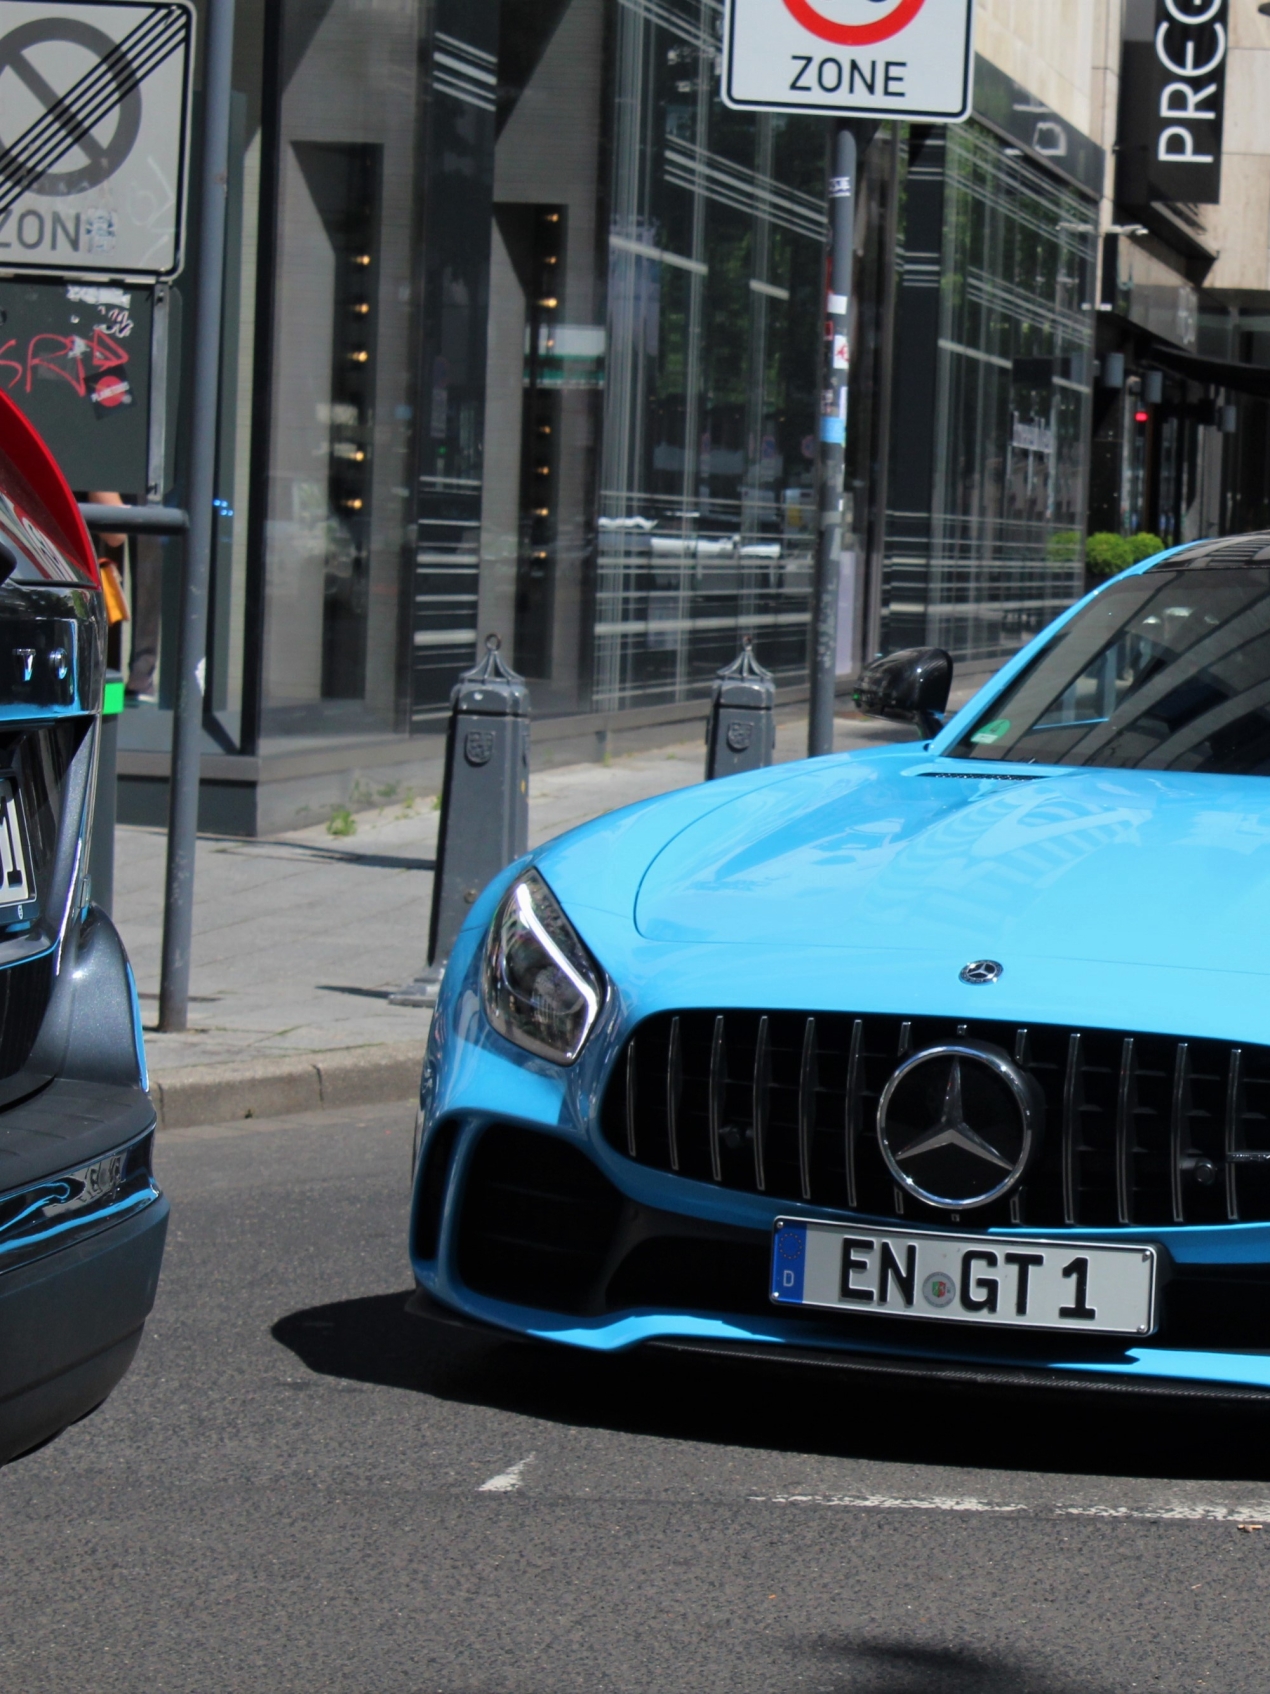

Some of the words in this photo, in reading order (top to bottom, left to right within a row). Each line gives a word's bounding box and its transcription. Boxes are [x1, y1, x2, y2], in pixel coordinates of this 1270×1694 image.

[789, 55, 907, 97] ZONE
[782, 1270, 795, 1288] D
[840, 1236, 918, 1306] EN
[960, 1249, 1045, 1315] GT
[1058, 1257, 1097, 1320] 1
